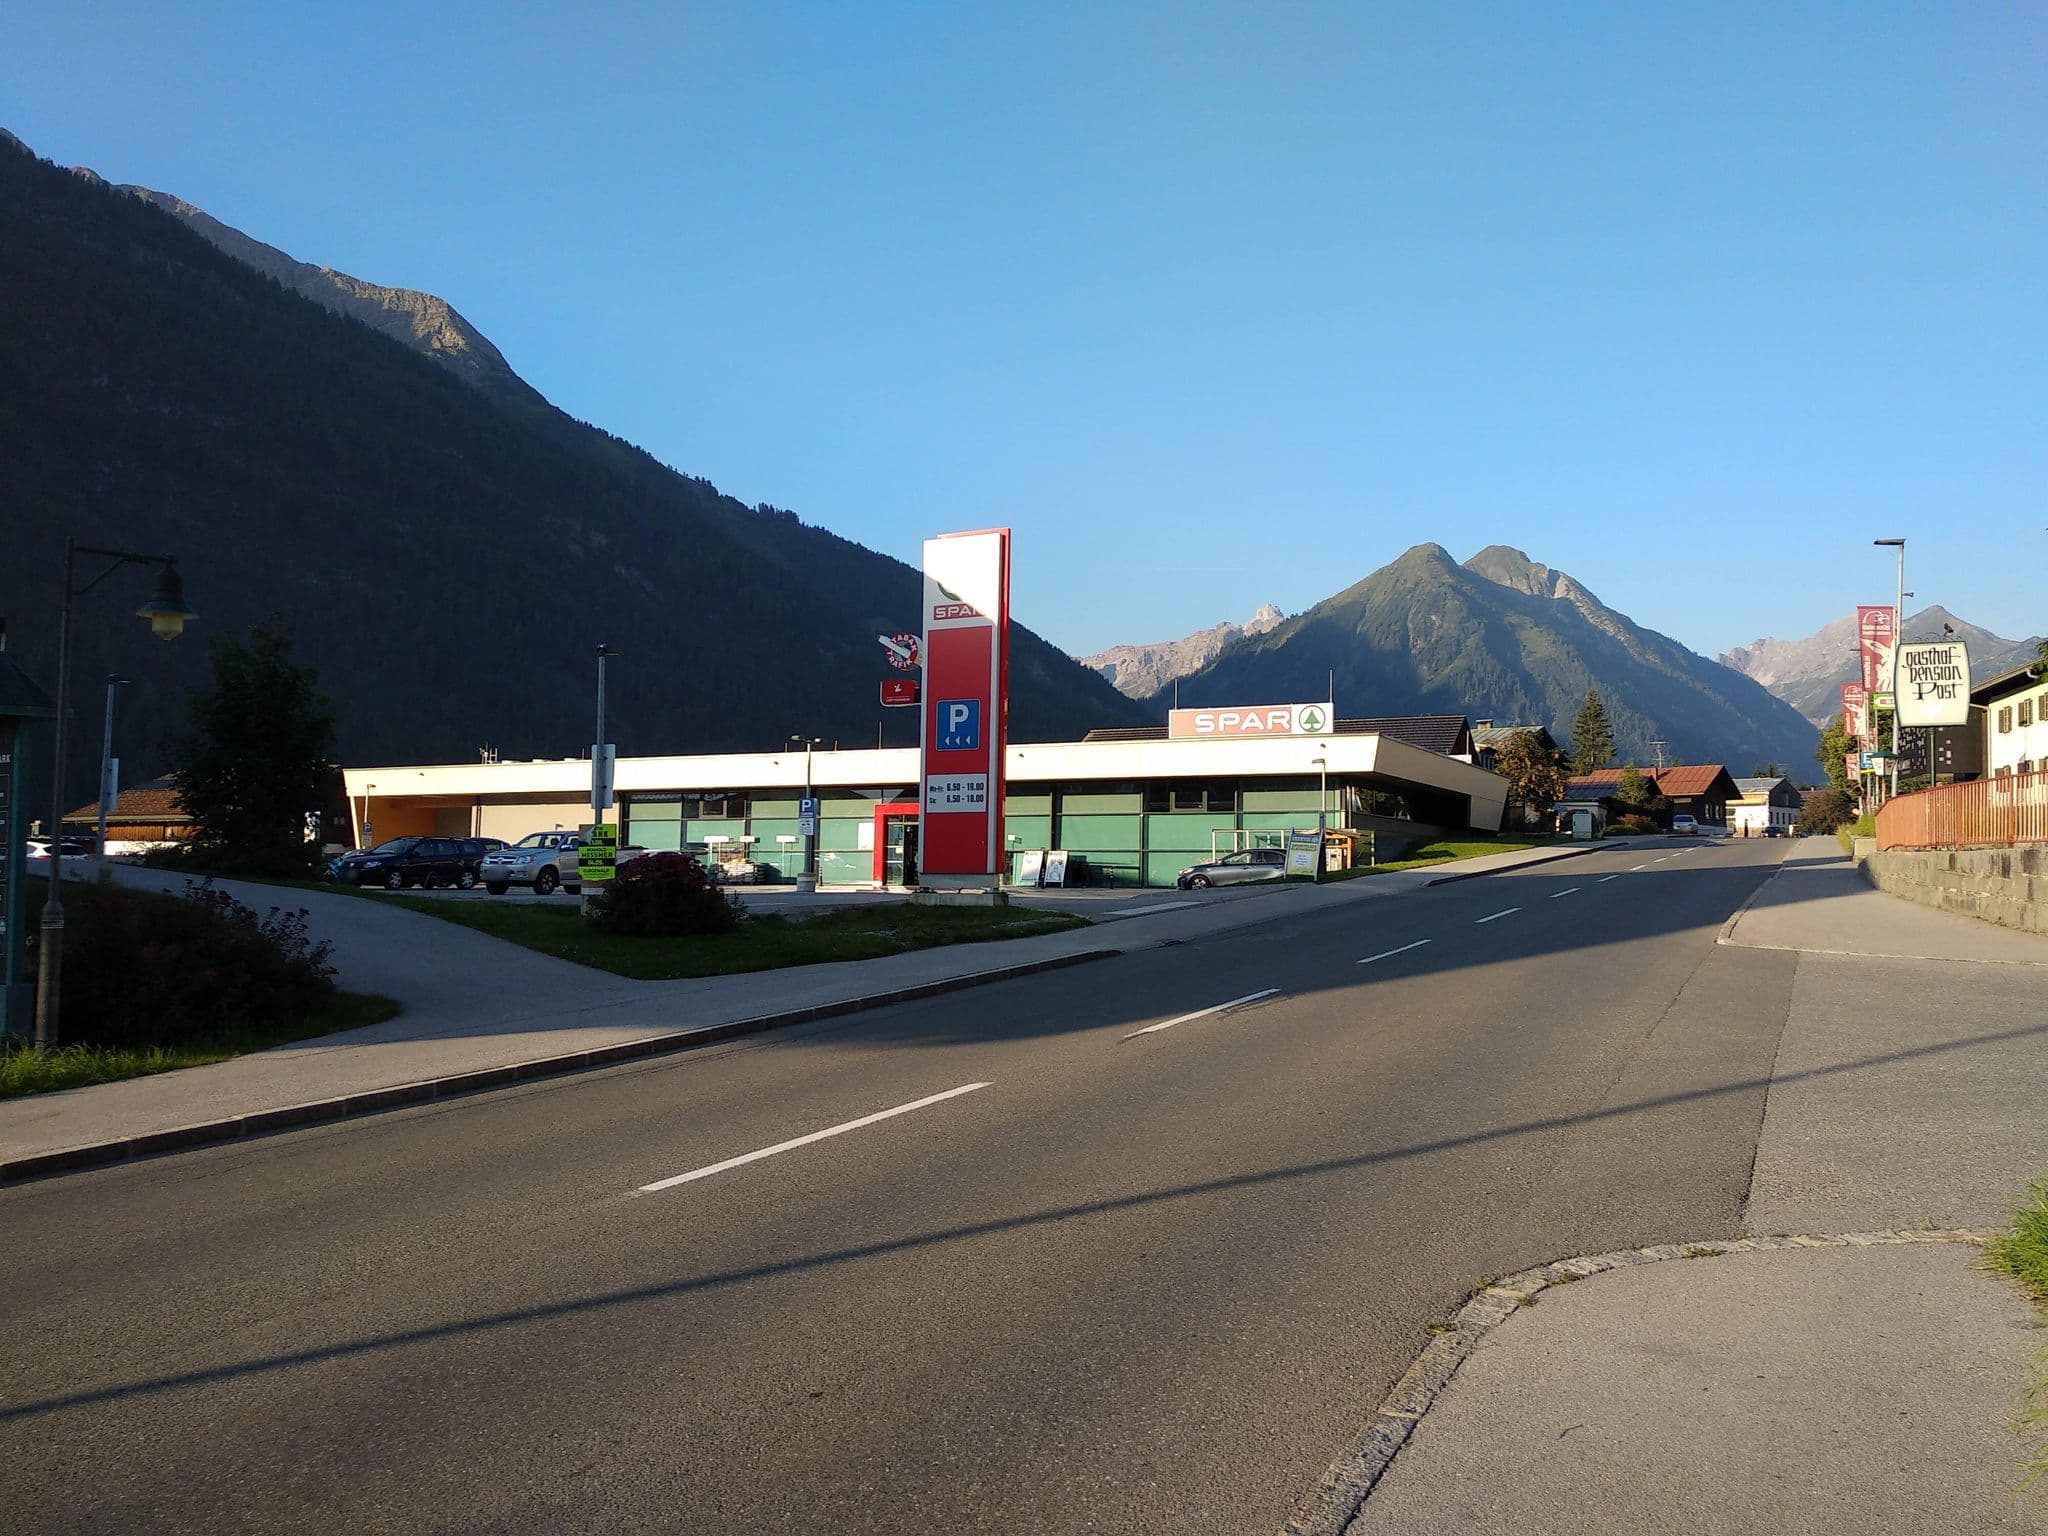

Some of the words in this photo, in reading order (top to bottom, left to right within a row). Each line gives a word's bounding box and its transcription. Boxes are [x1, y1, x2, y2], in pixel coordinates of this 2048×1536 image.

[887, 649, 913, 669] TRAFIK
[1901, 646, 1961, 668] gasthof
[1909, 665, 1963, 683] pension
[1911, 681, 1964, 700] Post
[949, 703, 970, 733] P
[1194, 710, 1291, 733] SPAR
[946, 782, 961, 792] 6.50
[966, 782, 985, 792] 19.00
[801, 799, 812, 812] P
[946, 794, 961, 804] 6.50
[966, 794, 985, 804] 18.00
